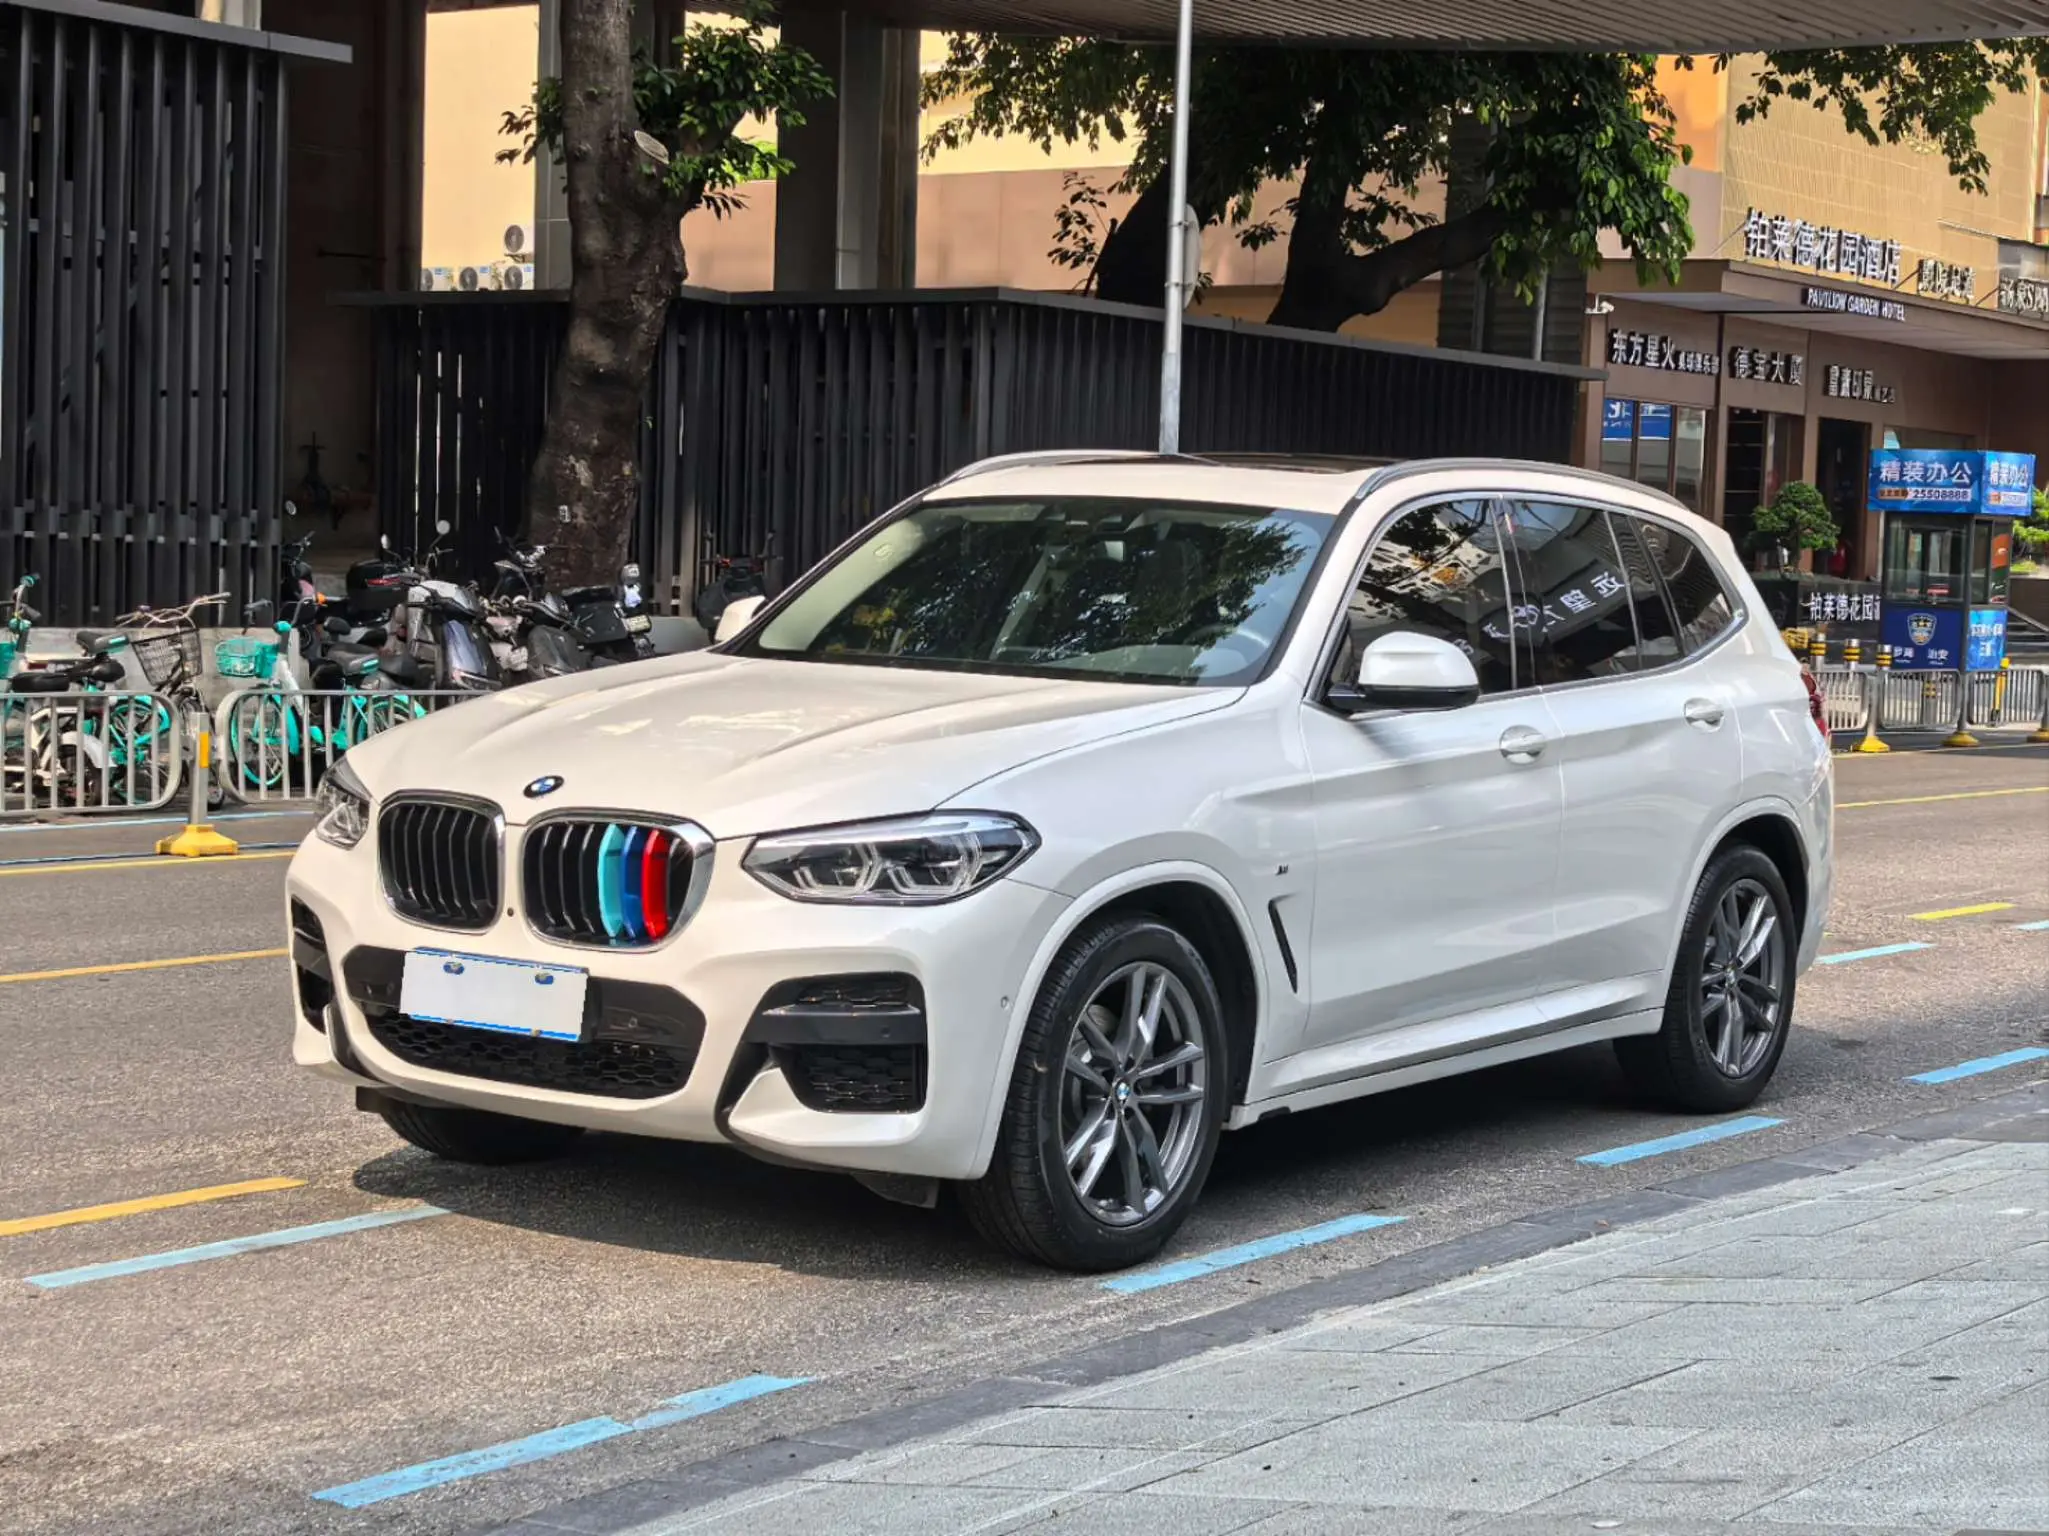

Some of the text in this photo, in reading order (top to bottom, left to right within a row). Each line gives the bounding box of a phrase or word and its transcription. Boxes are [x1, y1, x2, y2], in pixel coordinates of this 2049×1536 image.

[1847, 295, 1880, 317] GARDEN
[1881, 300, 1905, 322] HOTEL
[1879, 458, 1972, 484] 精装办公
